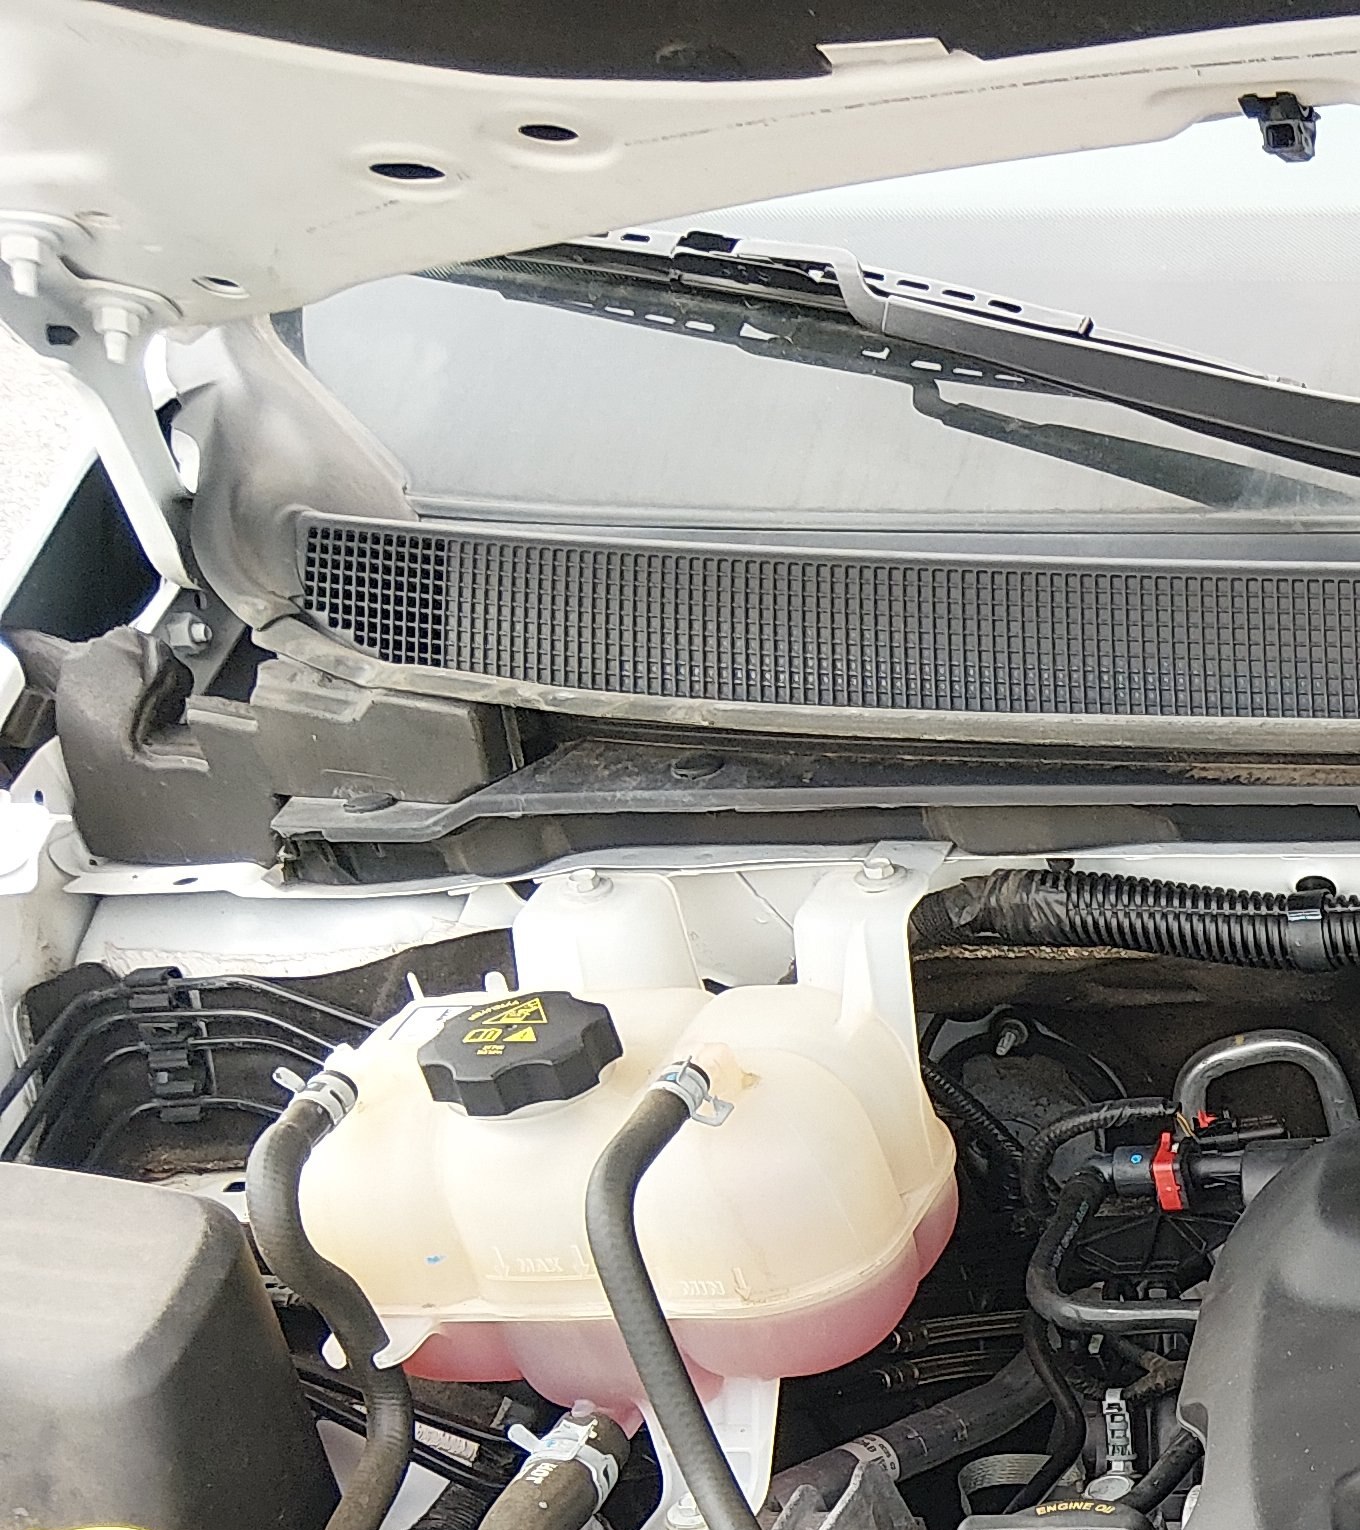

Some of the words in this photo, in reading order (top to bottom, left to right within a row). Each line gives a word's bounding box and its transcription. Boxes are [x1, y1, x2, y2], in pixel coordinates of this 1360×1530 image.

[516, 1257, 562, 1273] MAX
[679, 1280, 725, 1296] MIN
[1036, 1502, 1094, 1515] ENGINE
[1095, 1504, 1116, 1514] OIL
